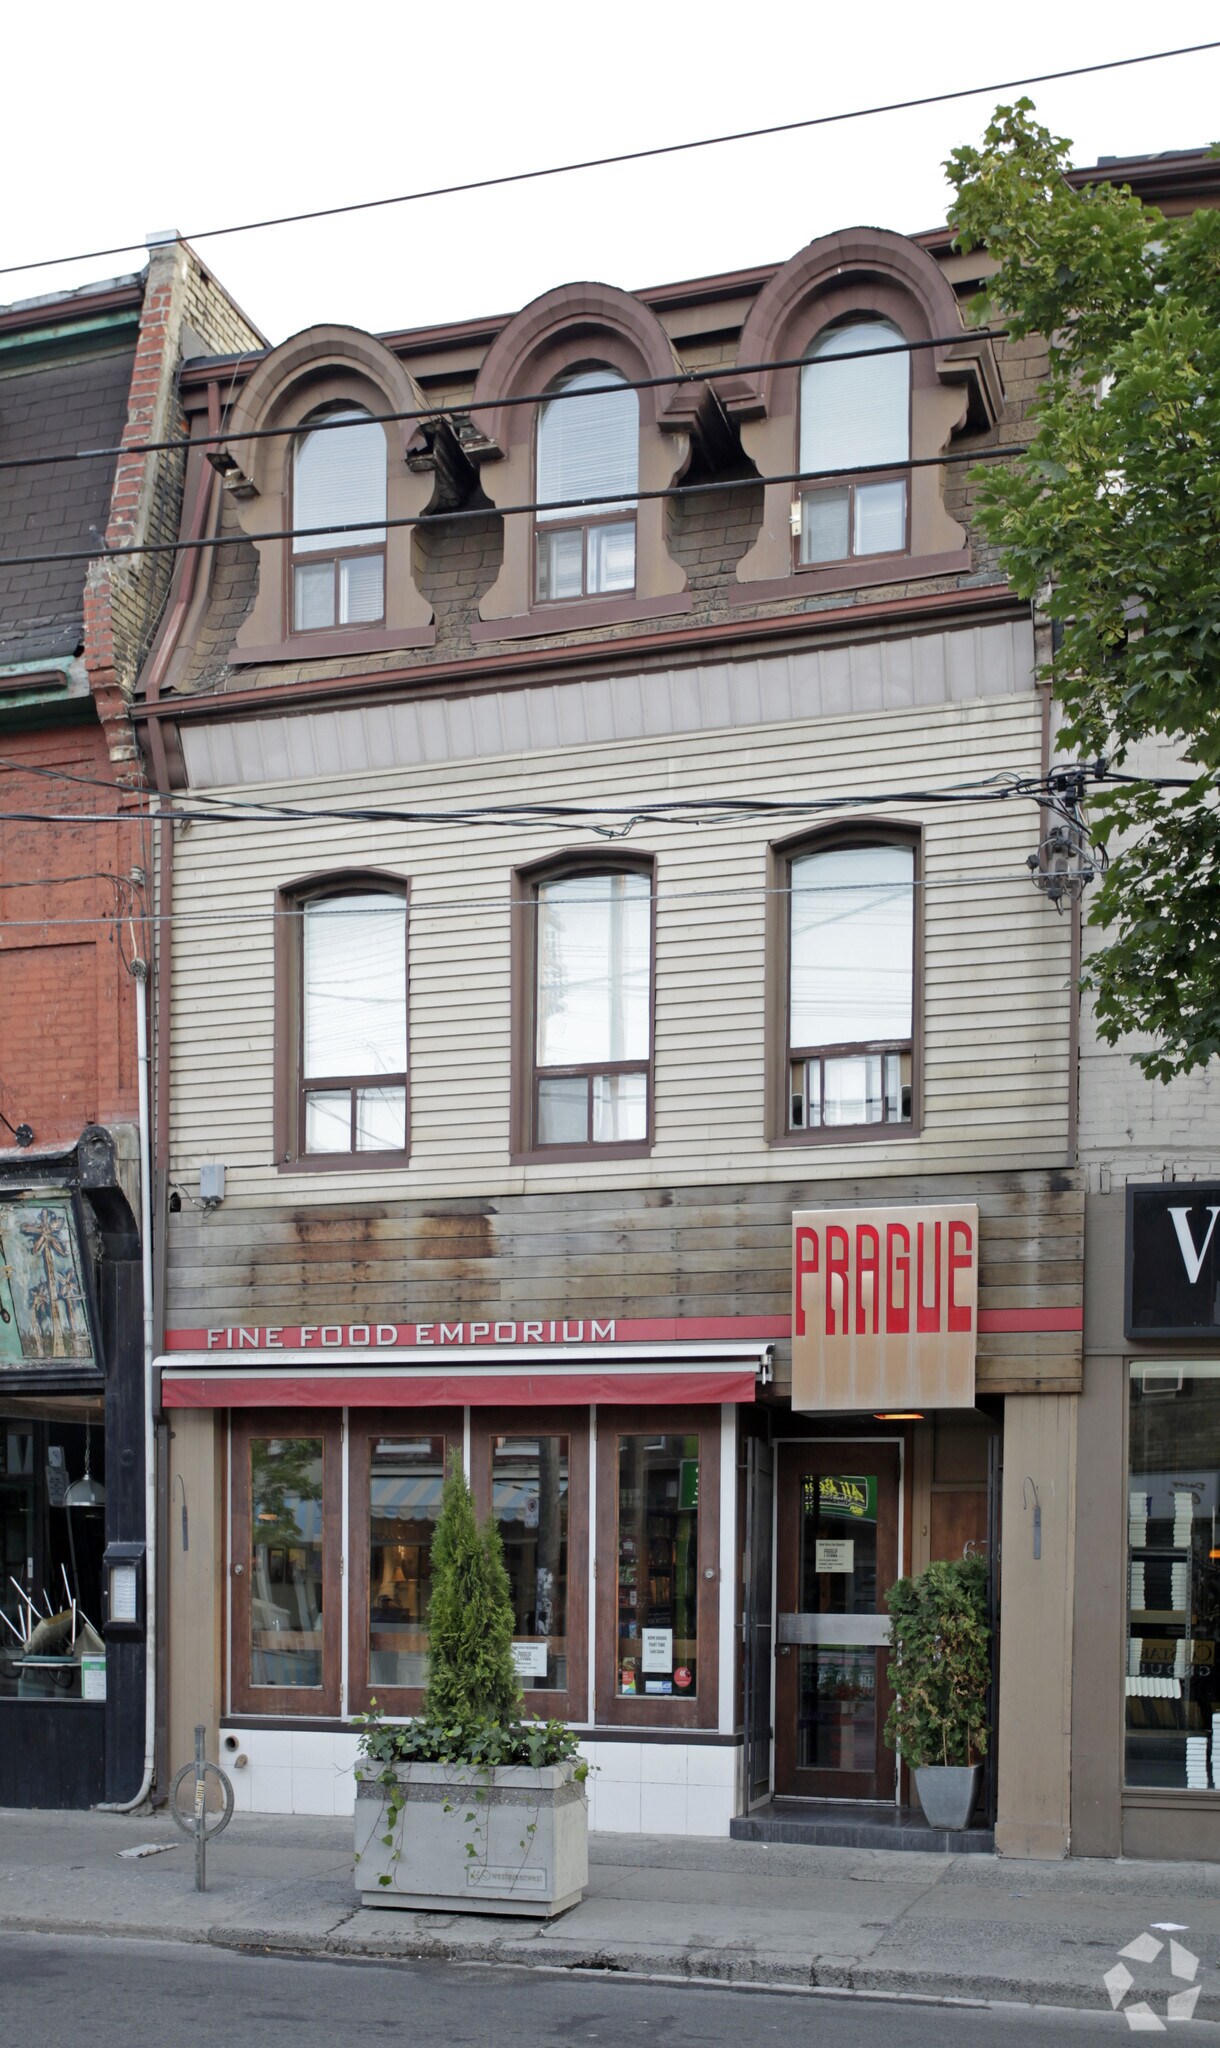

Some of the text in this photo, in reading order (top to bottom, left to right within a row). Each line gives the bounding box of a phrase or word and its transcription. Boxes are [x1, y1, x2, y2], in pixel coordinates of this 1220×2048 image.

[796, 1220, 972, 1336] PRAGUE
[1167, 1206, 1220, 1283] V
[207, 1319, 617, 1349] FINE FOOD EMPORIUM
